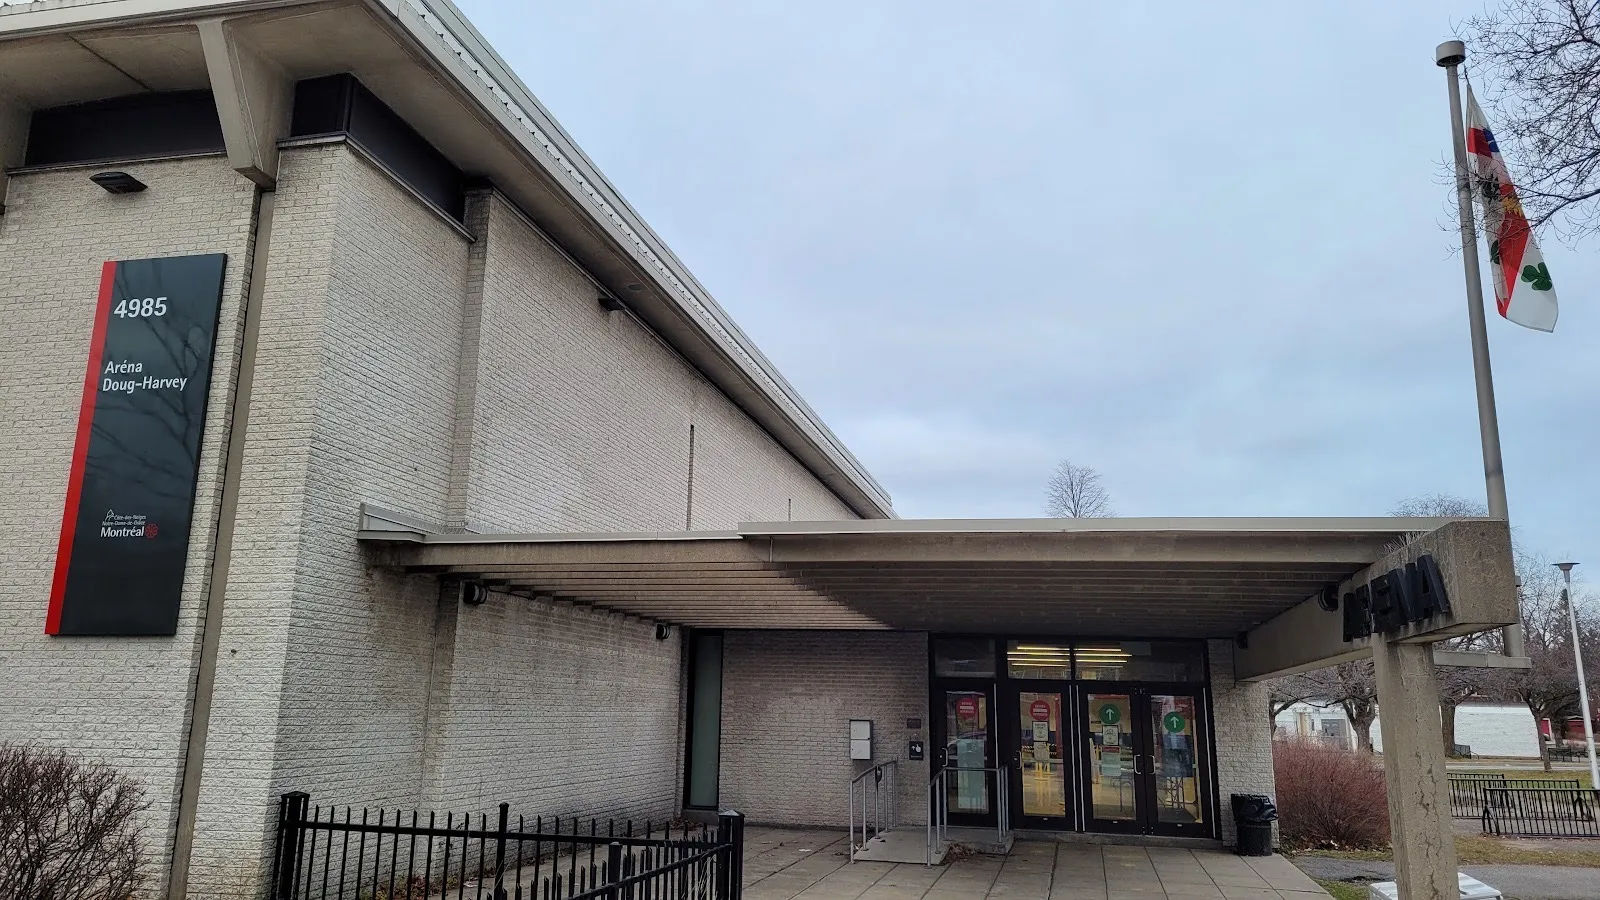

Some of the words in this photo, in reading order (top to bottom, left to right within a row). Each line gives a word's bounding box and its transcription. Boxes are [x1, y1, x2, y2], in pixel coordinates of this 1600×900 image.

[113, 296, 168, 319] 4985
[104, 359, 143, 375] Aréna
[102, 375, 188, 394] Doug-Harvey
[100, 526, 145, 538] Montréal
